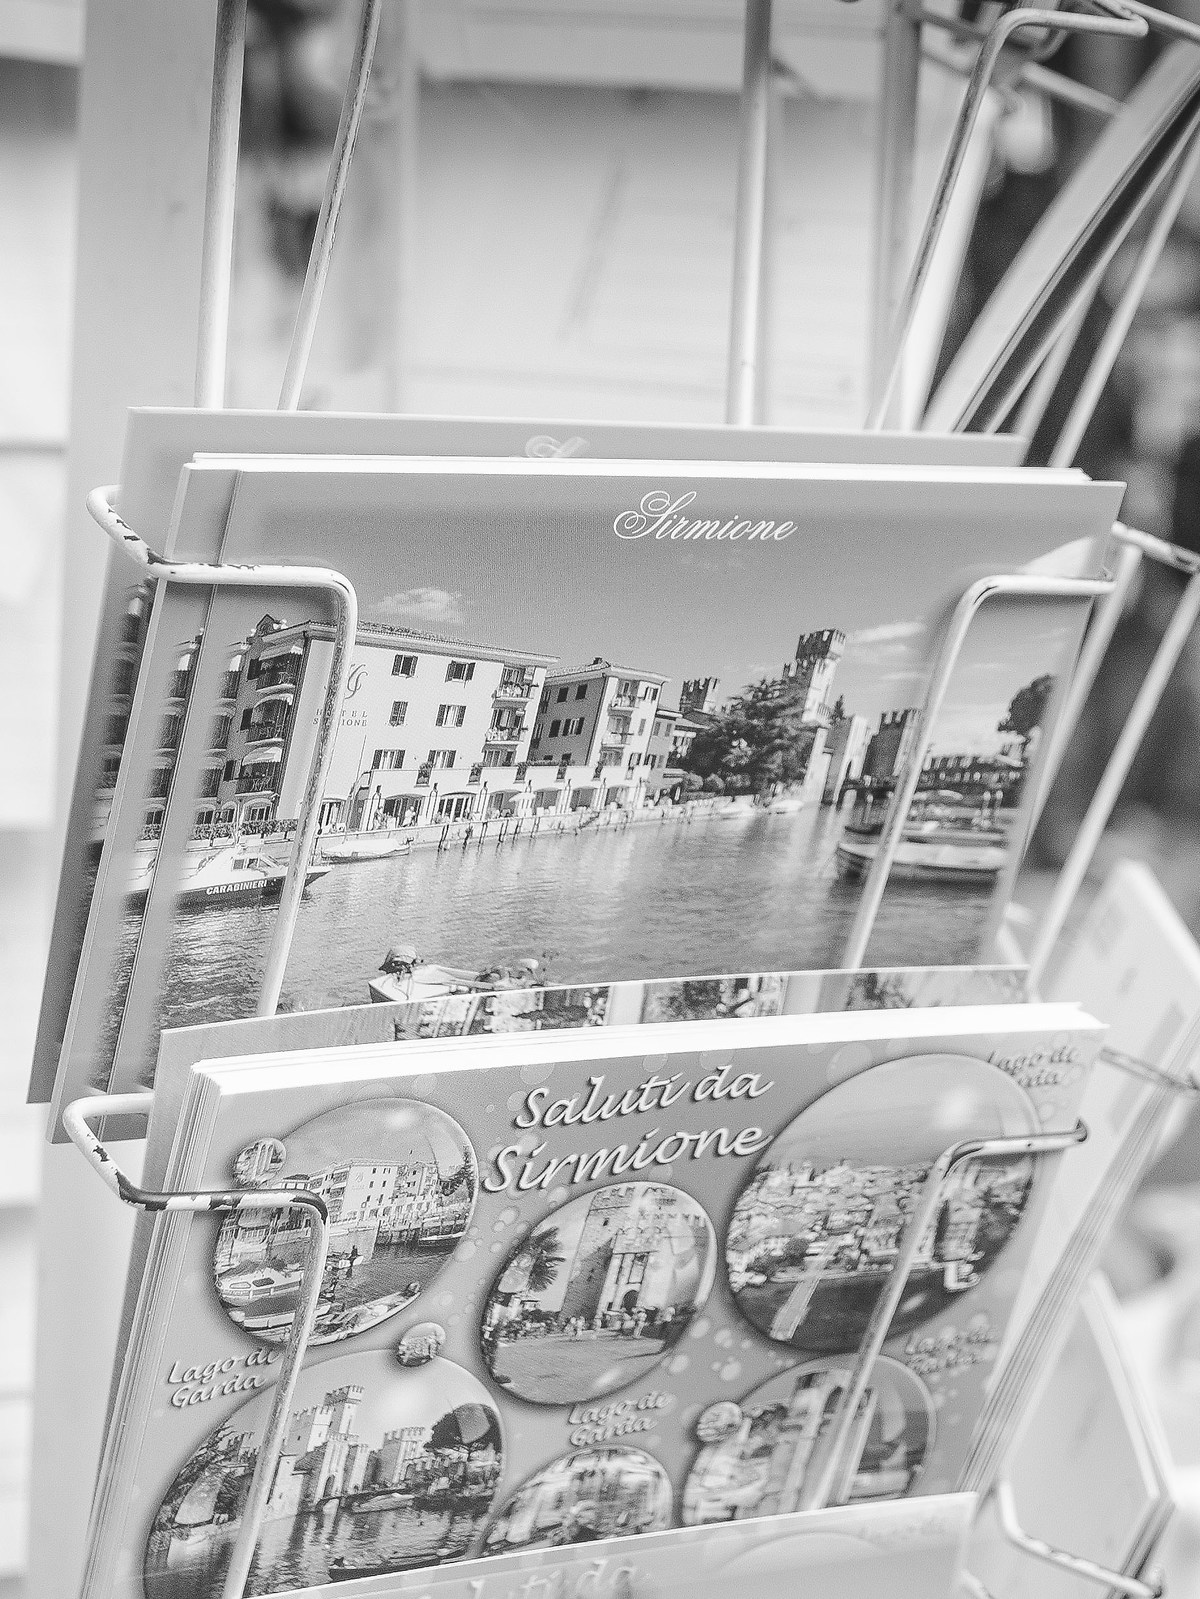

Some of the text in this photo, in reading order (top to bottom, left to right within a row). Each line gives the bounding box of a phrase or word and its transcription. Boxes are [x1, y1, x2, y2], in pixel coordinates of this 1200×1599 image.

[613, 490, 798, 541] Sirmione
[313, 718, 368, 727] SIONE
[316, 708, 368, 718] HTEL
[206, 880, 268, 895] CARABINIERI
[515, 1064, 775, 1128] Saluti da
[482, 1126, 774, 1193] Sirmione
[168, 1355, 243, 1384] Lago
[170, 1373, 266, 1408] Garda
